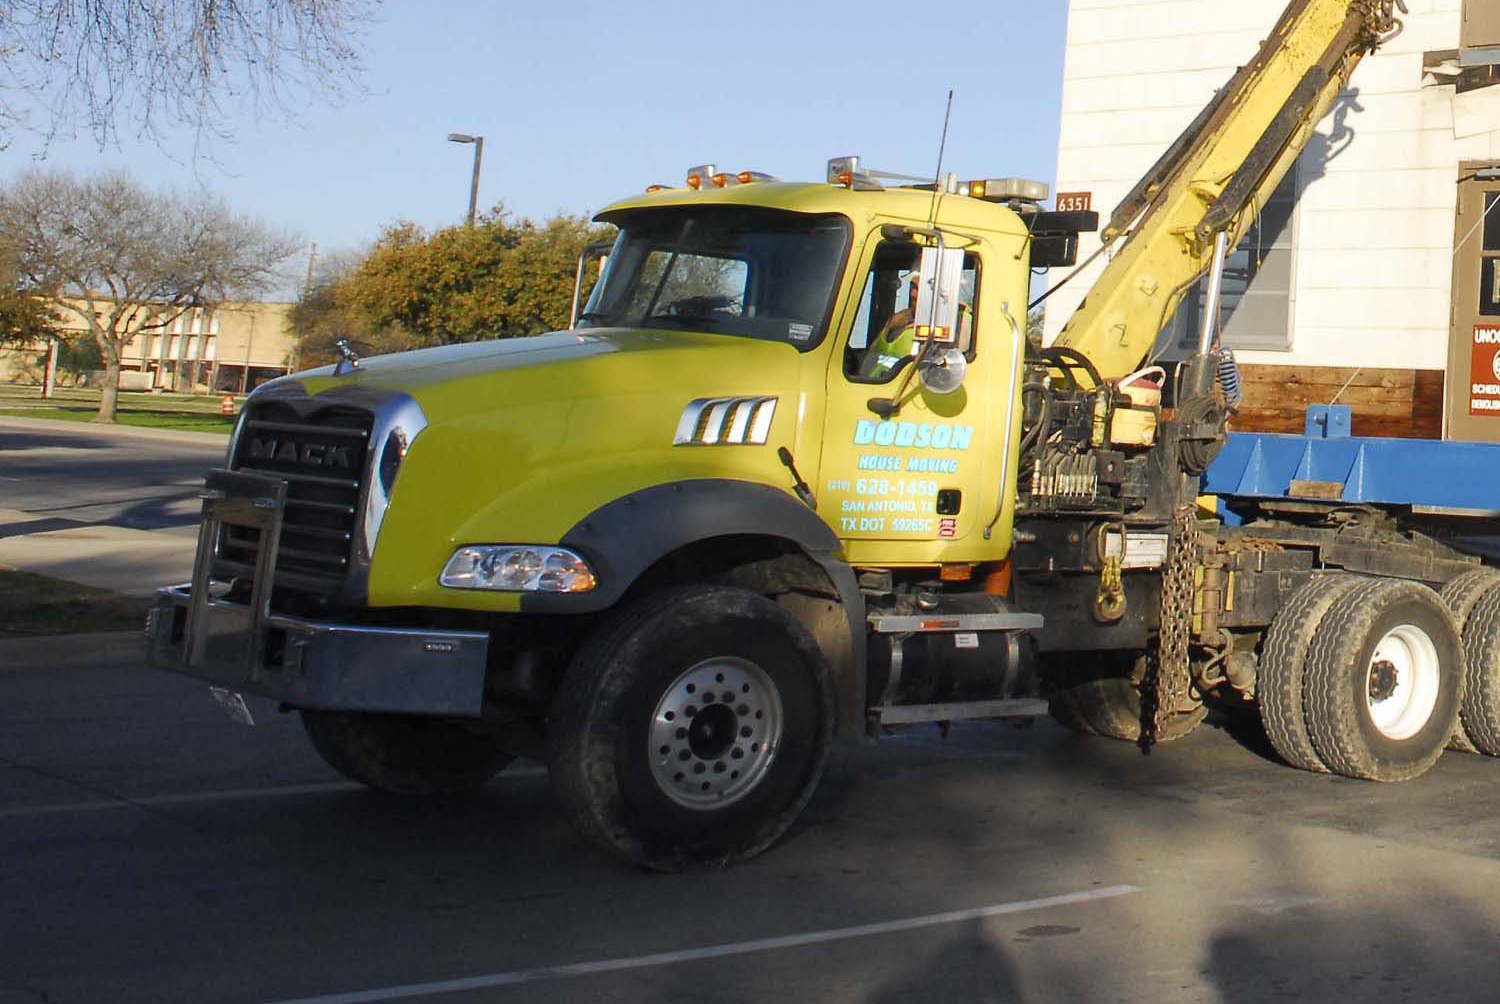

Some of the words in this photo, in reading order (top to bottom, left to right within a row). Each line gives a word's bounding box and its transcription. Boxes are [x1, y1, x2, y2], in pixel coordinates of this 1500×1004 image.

[1058, 196, 1089, 212] 6351
[854, 420, 973, 451] DODSON
[250, 438, 349, 467] MACK
[858, 455, 902, 471] HOUSE
[906, 456, 959, 474] MOVING
[856, 477, 938, 496] 628-1459
[841, 499, 866, 513] SAN
[840, 517, 858, 532] TX
[859, 517, 887, 532] DOT
